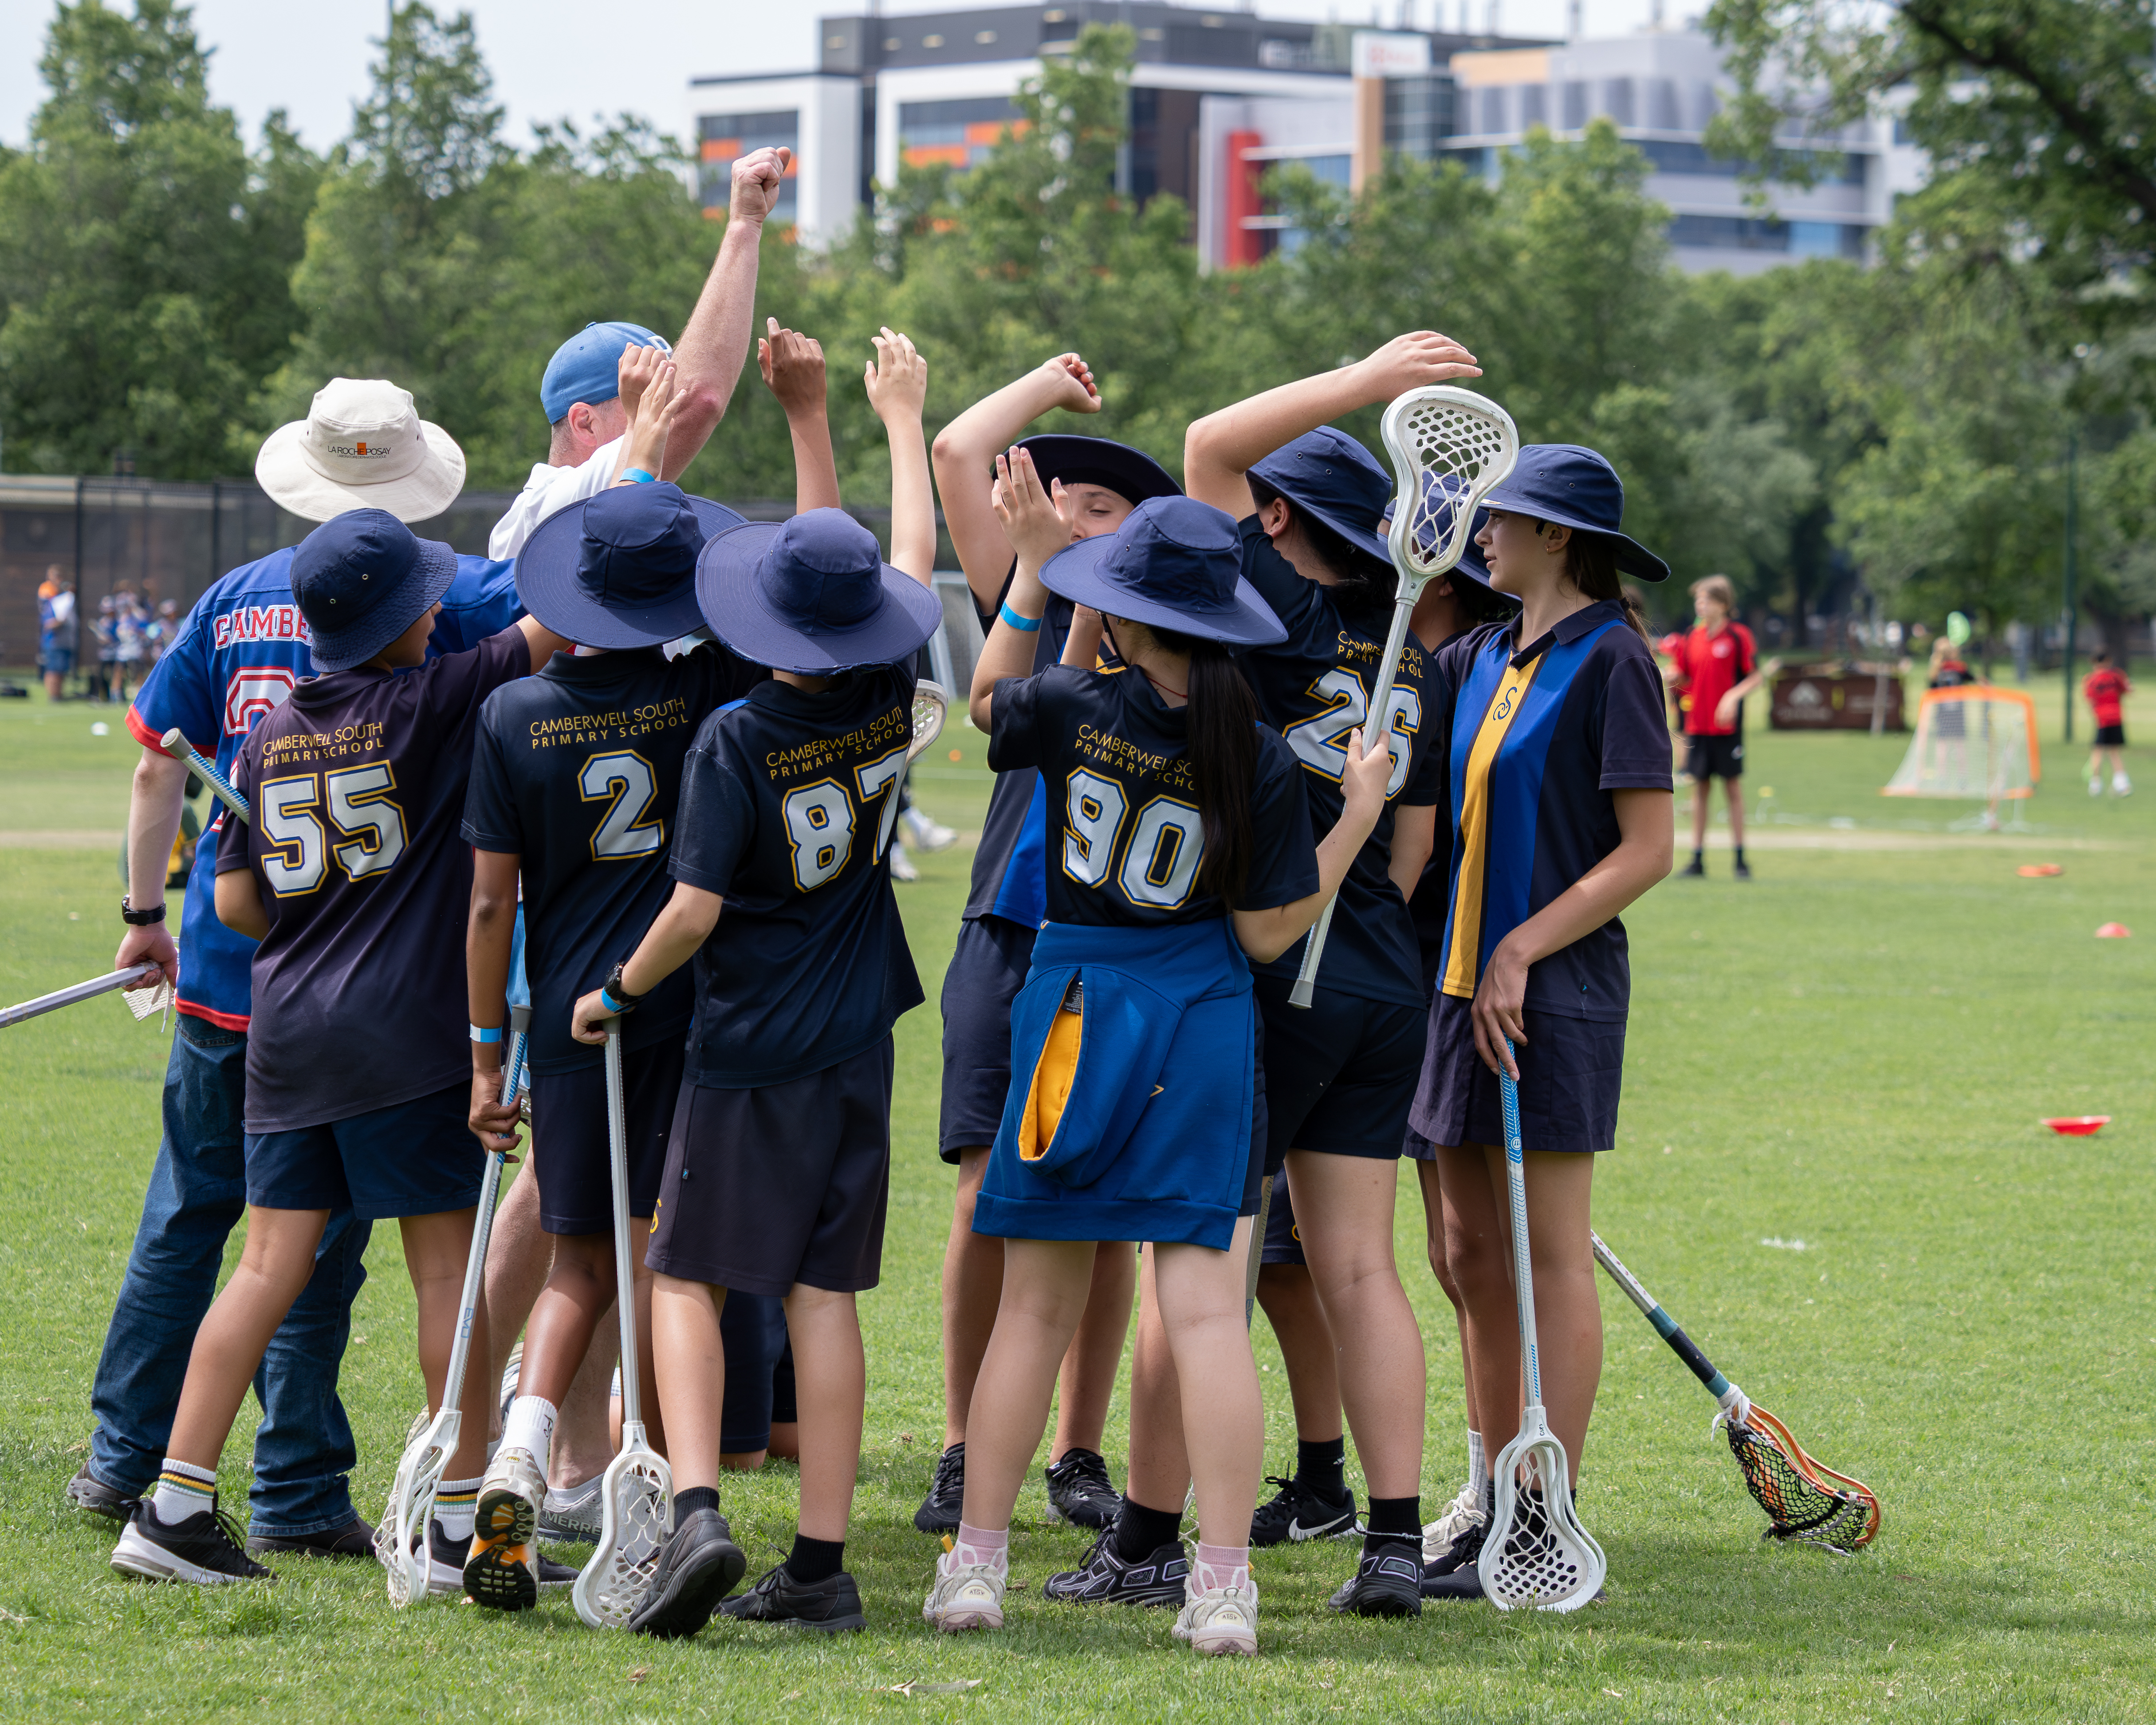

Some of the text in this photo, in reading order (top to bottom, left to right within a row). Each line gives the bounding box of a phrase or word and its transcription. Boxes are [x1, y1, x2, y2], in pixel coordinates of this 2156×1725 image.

[337, 447, 365, 455] ROCHE
[212, 604, 312, 650] CAMBE
[1398, 662, 1423, 678] HOOL
[530, 697, 685, 736] CAMBERWELL SOUTH
[532, 713, 689, 749] PRIMARY SCHOOL
[1282, 666, 1422, 801] 26
[263, 722, 383, 756] CAMBERWELL SOUTH
[264, 738, 384, 769] PRIMARY SCHOOL
[766, 729, 866, 766] CAMBERWELL
[770, 724, 907, 780] PRIMARY SCHOO
[1079, 725, 1172, 771] CAMBERWELL
[1075, 739, 1147, 777] PRIMARY
[1154, 773, 1194, 791] SCHO
[577, 749, 664, 862] 2
[782, 738, 911, 894] 87
[260, 760, 409, 898] 55
[1062, 765, 1205, 910] 90
[460, 1308, 474, 1339] EVO
[545, 1510, 602, 1536] MERRE
